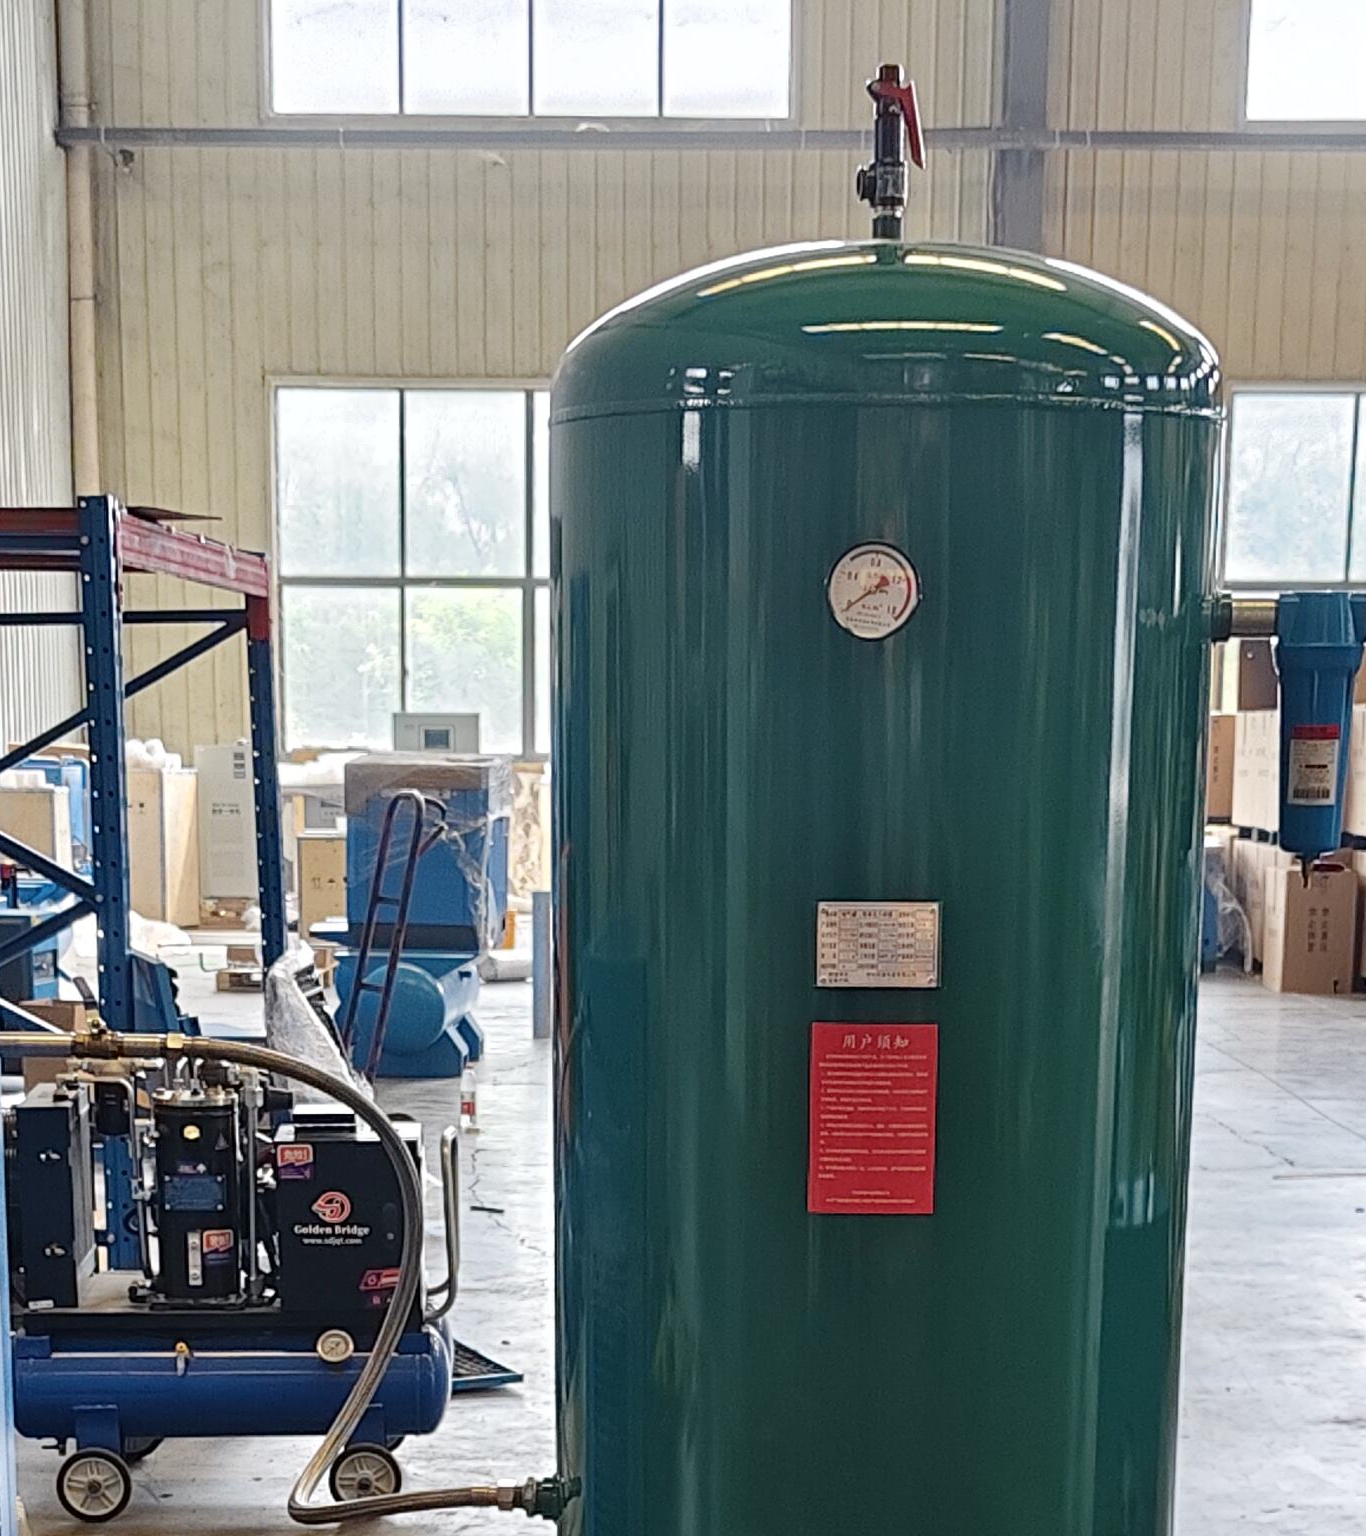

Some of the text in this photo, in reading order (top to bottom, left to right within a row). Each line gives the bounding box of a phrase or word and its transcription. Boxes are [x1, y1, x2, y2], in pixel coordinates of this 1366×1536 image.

[843, 1033, 909, 1049] 用户须知
[293, 1224, 370, 1236] Golden Bridge
